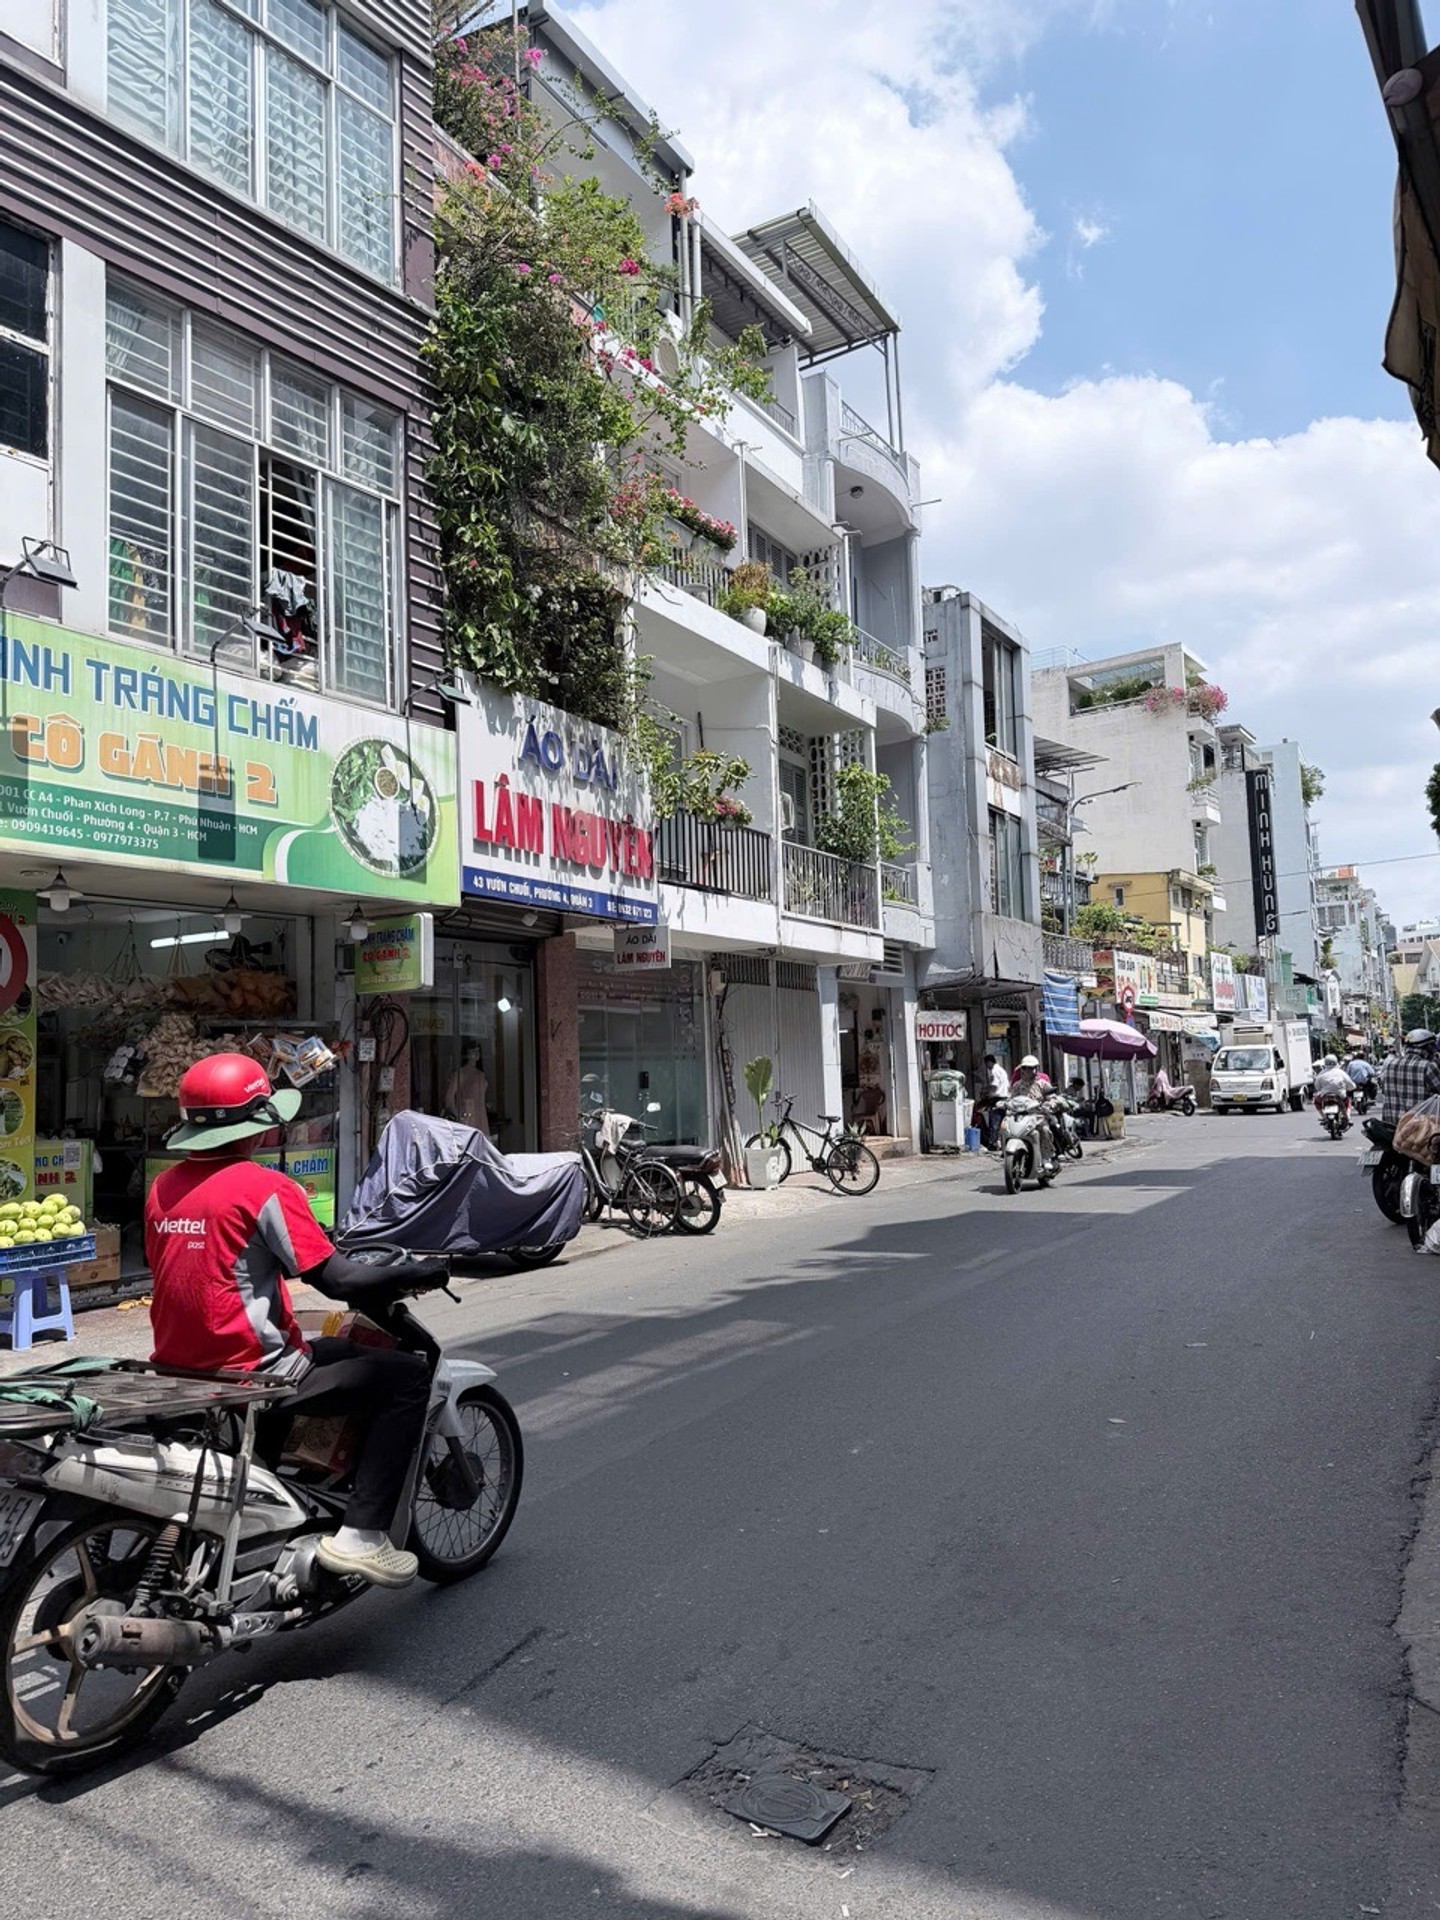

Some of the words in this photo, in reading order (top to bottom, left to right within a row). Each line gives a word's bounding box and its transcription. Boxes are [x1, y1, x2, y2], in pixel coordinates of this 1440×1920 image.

[0, 636, 69, 694] NH
[86, 659, 215, 727] TRÁNG
[229, 695, 318, 750] CHẤM
[12, 712, 83, 770] CÔ
[246, 761, 278, 804] 2
[520, 714, 564, 771] ÁO
[38, 791, 54, 803] A4
[64, 795, 92, 810] Phan
[94, 800, 117, 814] Xích
[119, 804, 146, 819] Long
[154, 810, 170, 823] P.7
[178, 813, 198, 826] Phú
[199, 817, 231, 832] Nhuận
[238, 823, 258, 835] HCM
[41, 807, 73, 822] Chuối
[83, 816, 126, 832] Phường
[127, 820, 134, 831] 4
[143, 823, 170, 836] Quận
[172, 827, 178, 837] 3
[187, 830, 207, 841] HCM
[473, 772, 544, 855] LÂM
[552, 803, 654, 880] NGUYÊN
[1255, 774, 1270, 847] MINH
[11, 819, 83, 839] 0909419645
[93, 831, 159, 849] 0977973375
[473, 875, 484, 888] 43
[588, 897, 593, 908] 3
[154, 1217, 206, 1235] viettel
[187, 1240, 205, 1250] post
